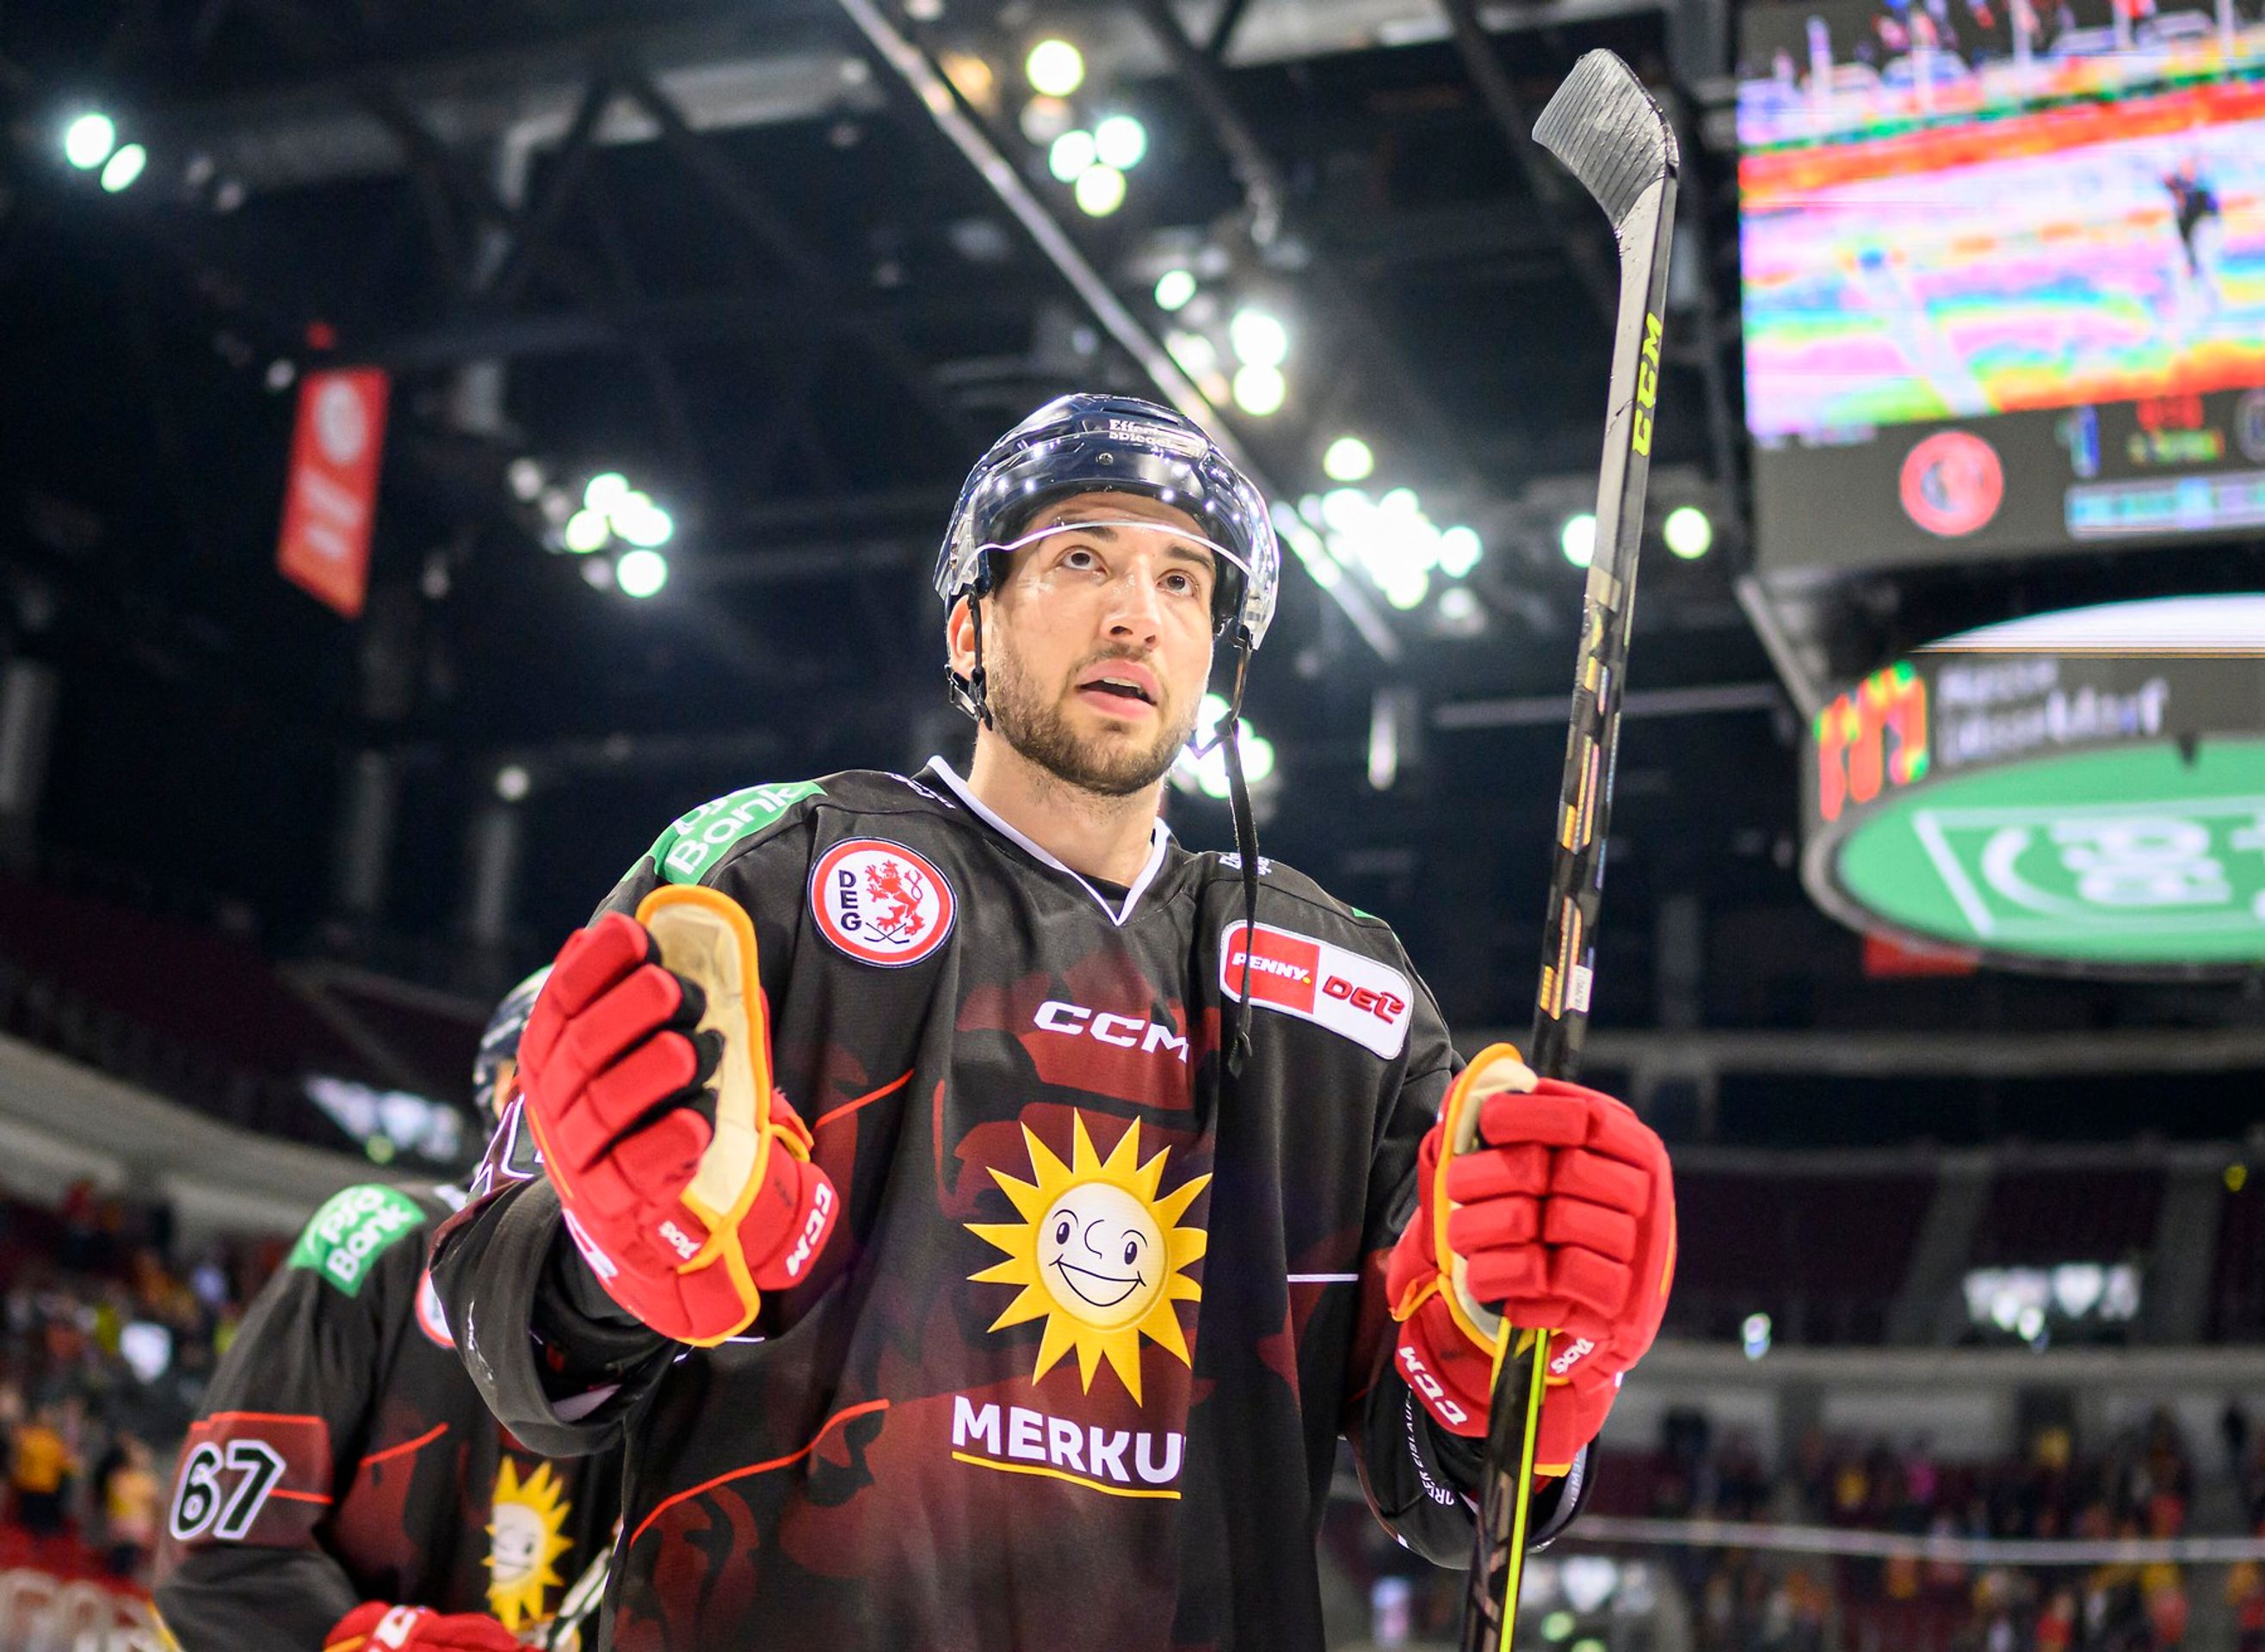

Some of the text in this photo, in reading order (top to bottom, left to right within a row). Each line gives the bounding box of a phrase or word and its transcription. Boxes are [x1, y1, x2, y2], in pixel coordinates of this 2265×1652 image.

[1632, 312, 1663, 456] CCM
[666, 786, 807, 875] Bank
[1034, 1001, 1188, 1063] CCM
[785, 1182, 833, 1277] CCM
[1398, 1346, 1468, 1426] CCM
[952, 1395, 1186, 1484] MERKU
[170, 1439, 287, 1540] 67
